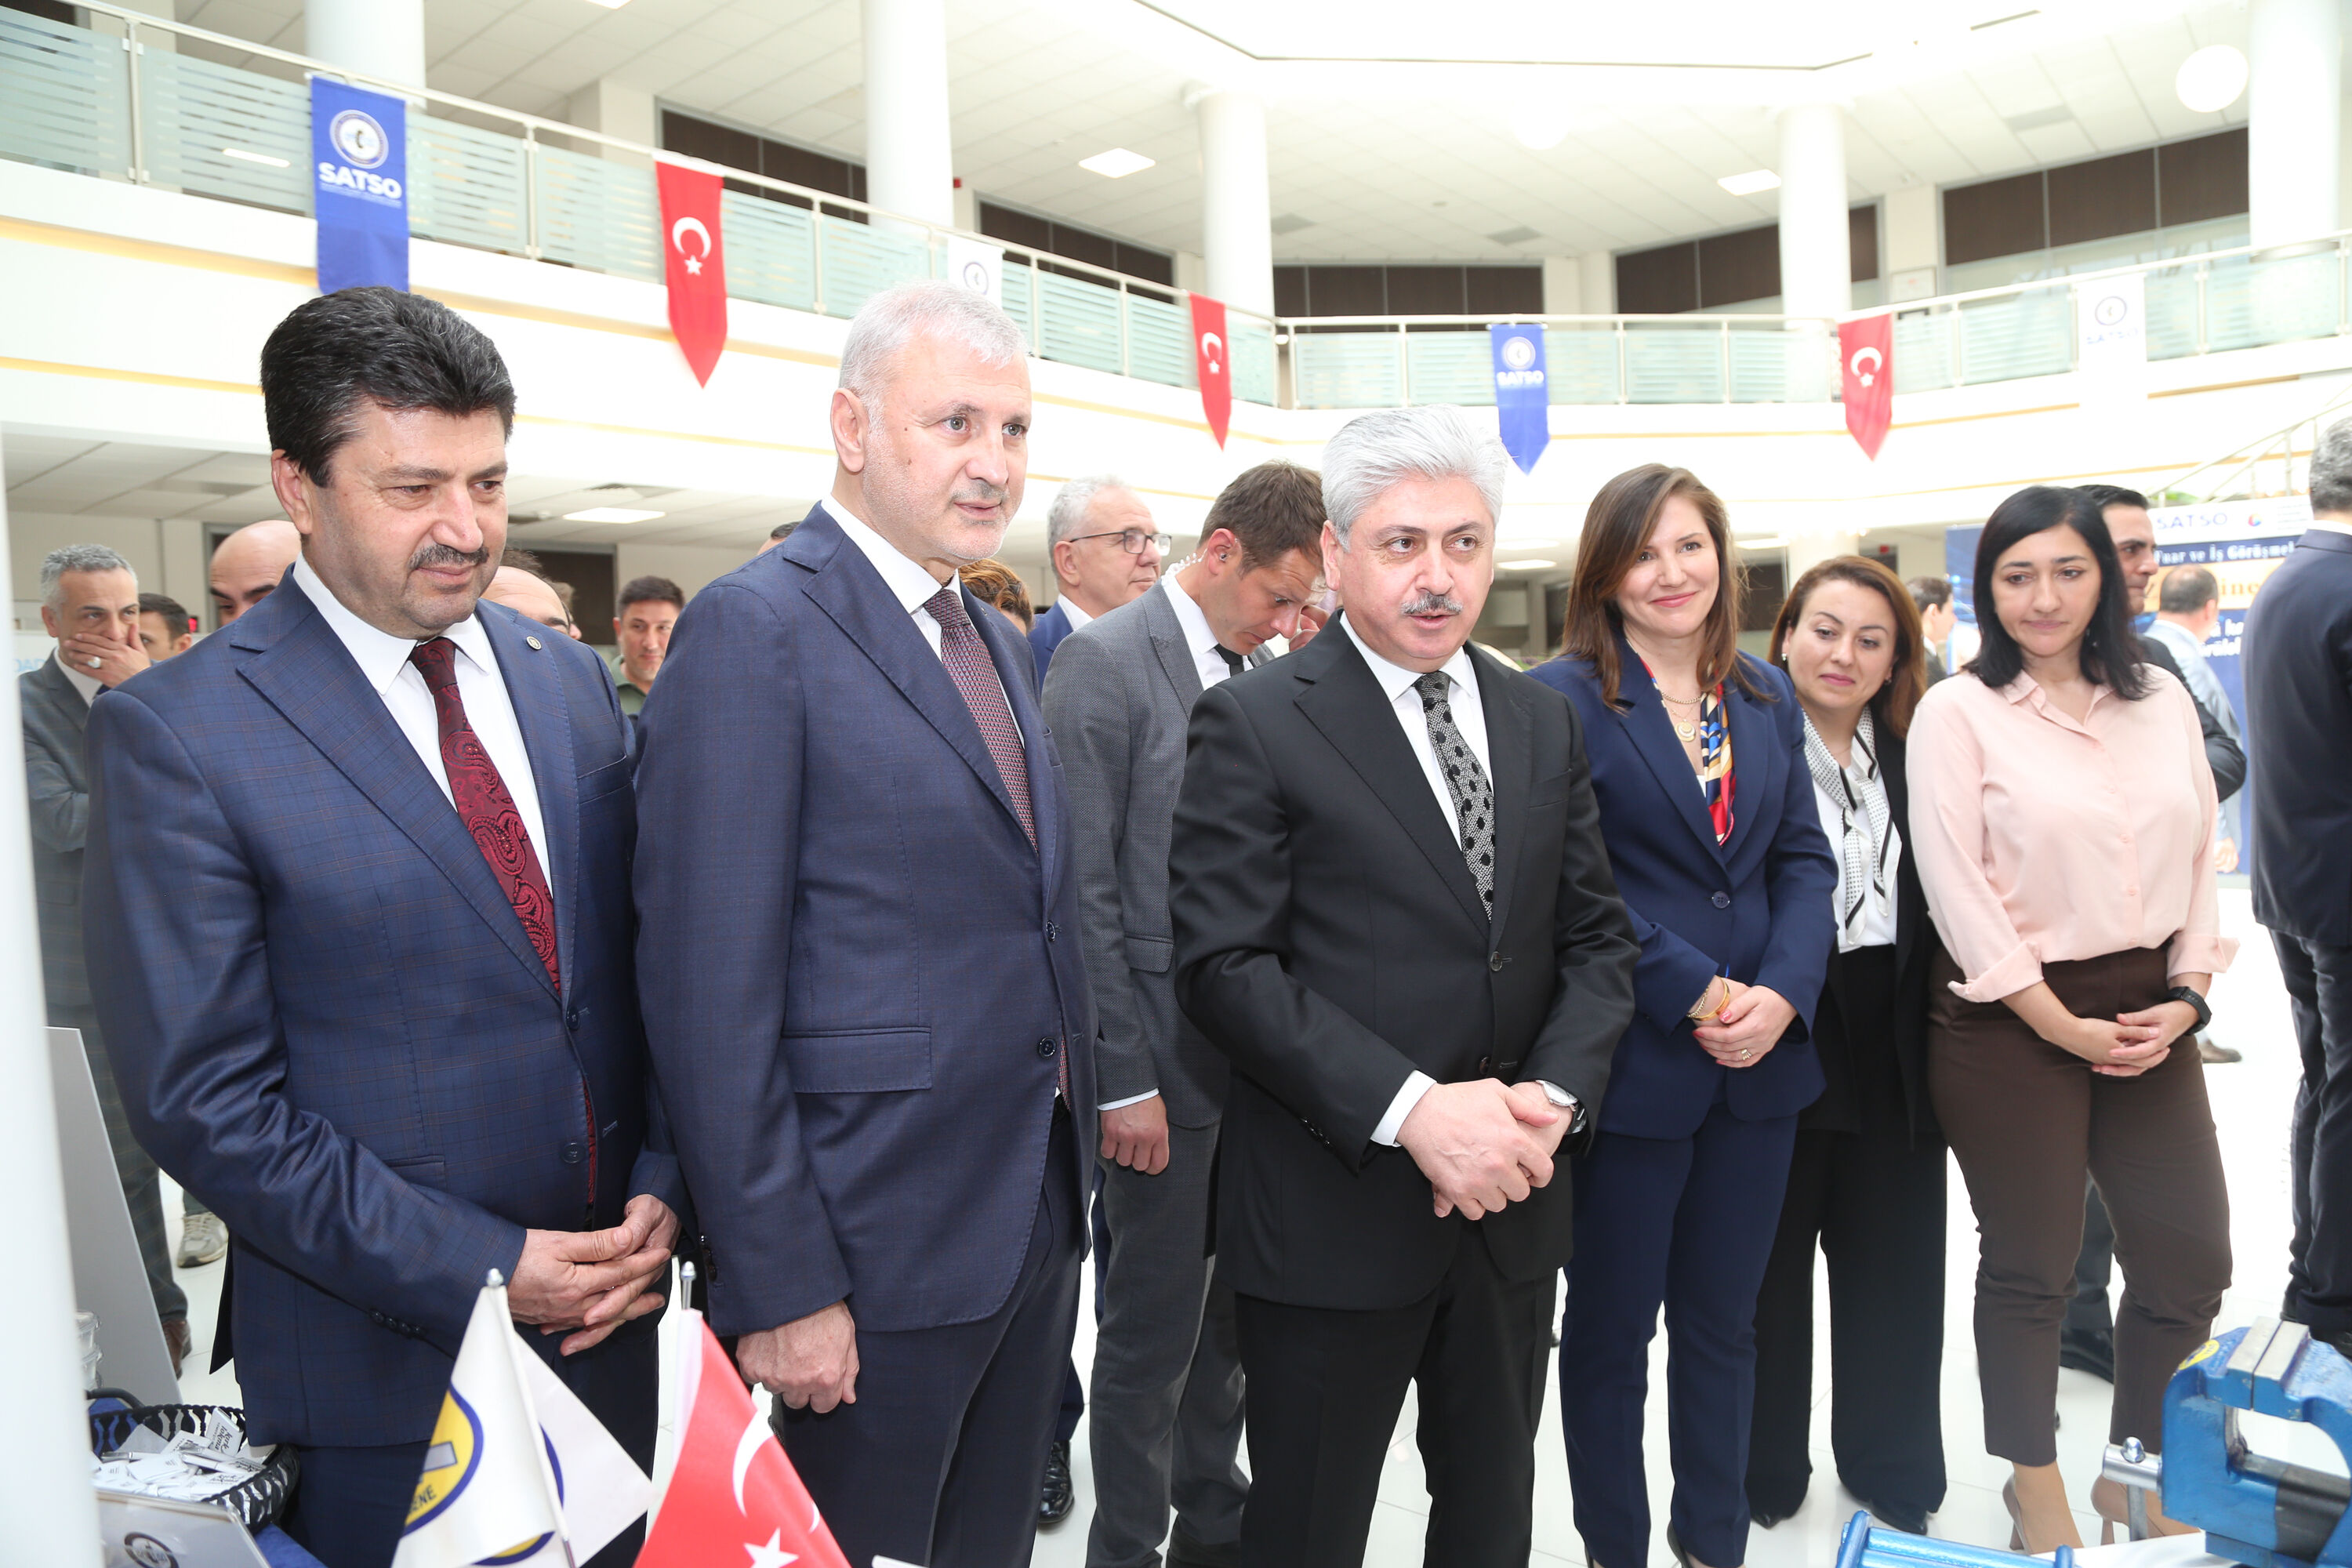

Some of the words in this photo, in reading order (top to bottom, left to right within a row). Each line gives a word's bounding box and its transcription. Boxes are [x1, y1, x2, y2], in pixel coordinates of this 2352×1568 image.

[318, 162, 402, 199] SATSO
[1497, 370, 1544, 387] SATSO
[2157, 512, 2227, 529] SATSO
[2189, 550, 2205, 561] ve
[215, 1425, 227, 1450] lokma
